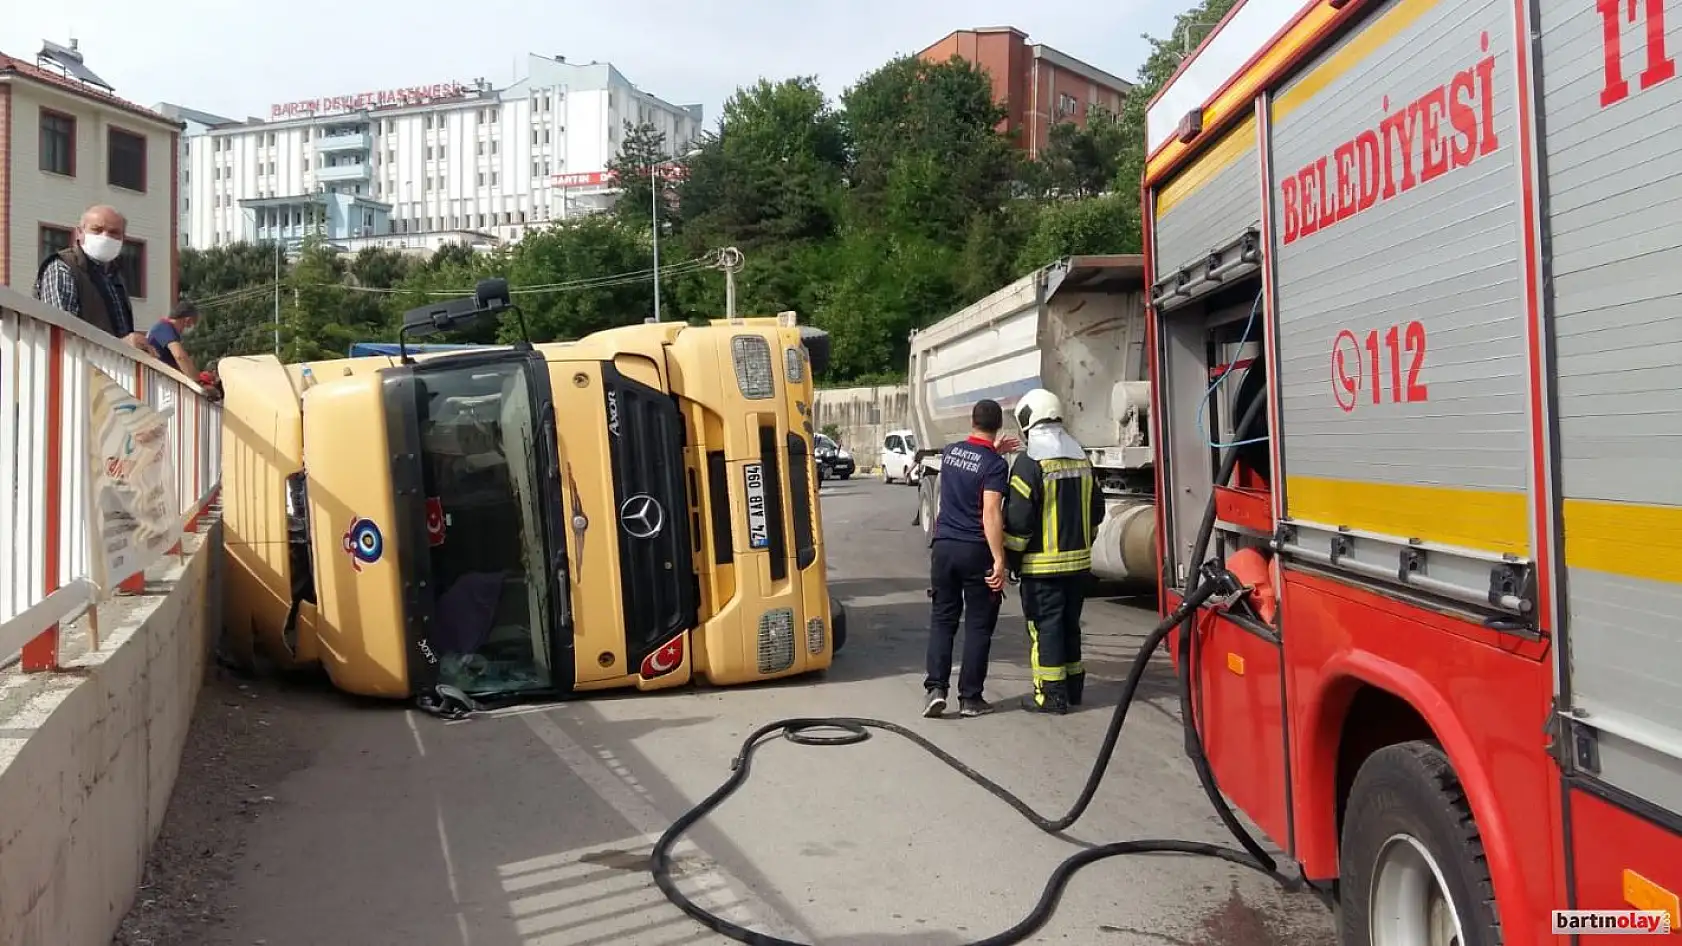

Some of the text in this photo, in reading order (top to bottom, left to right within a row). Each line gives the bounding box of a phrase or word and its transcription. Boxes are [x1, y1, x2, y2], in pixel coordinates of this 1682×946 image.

[323, 91, 375, 112] DEVLET
[1281, 31, 1498, 245] BELEDİYESİ
[1365, 321, 1428, 404] 112
[747, 467, 766, 539] 74 AAB 094
